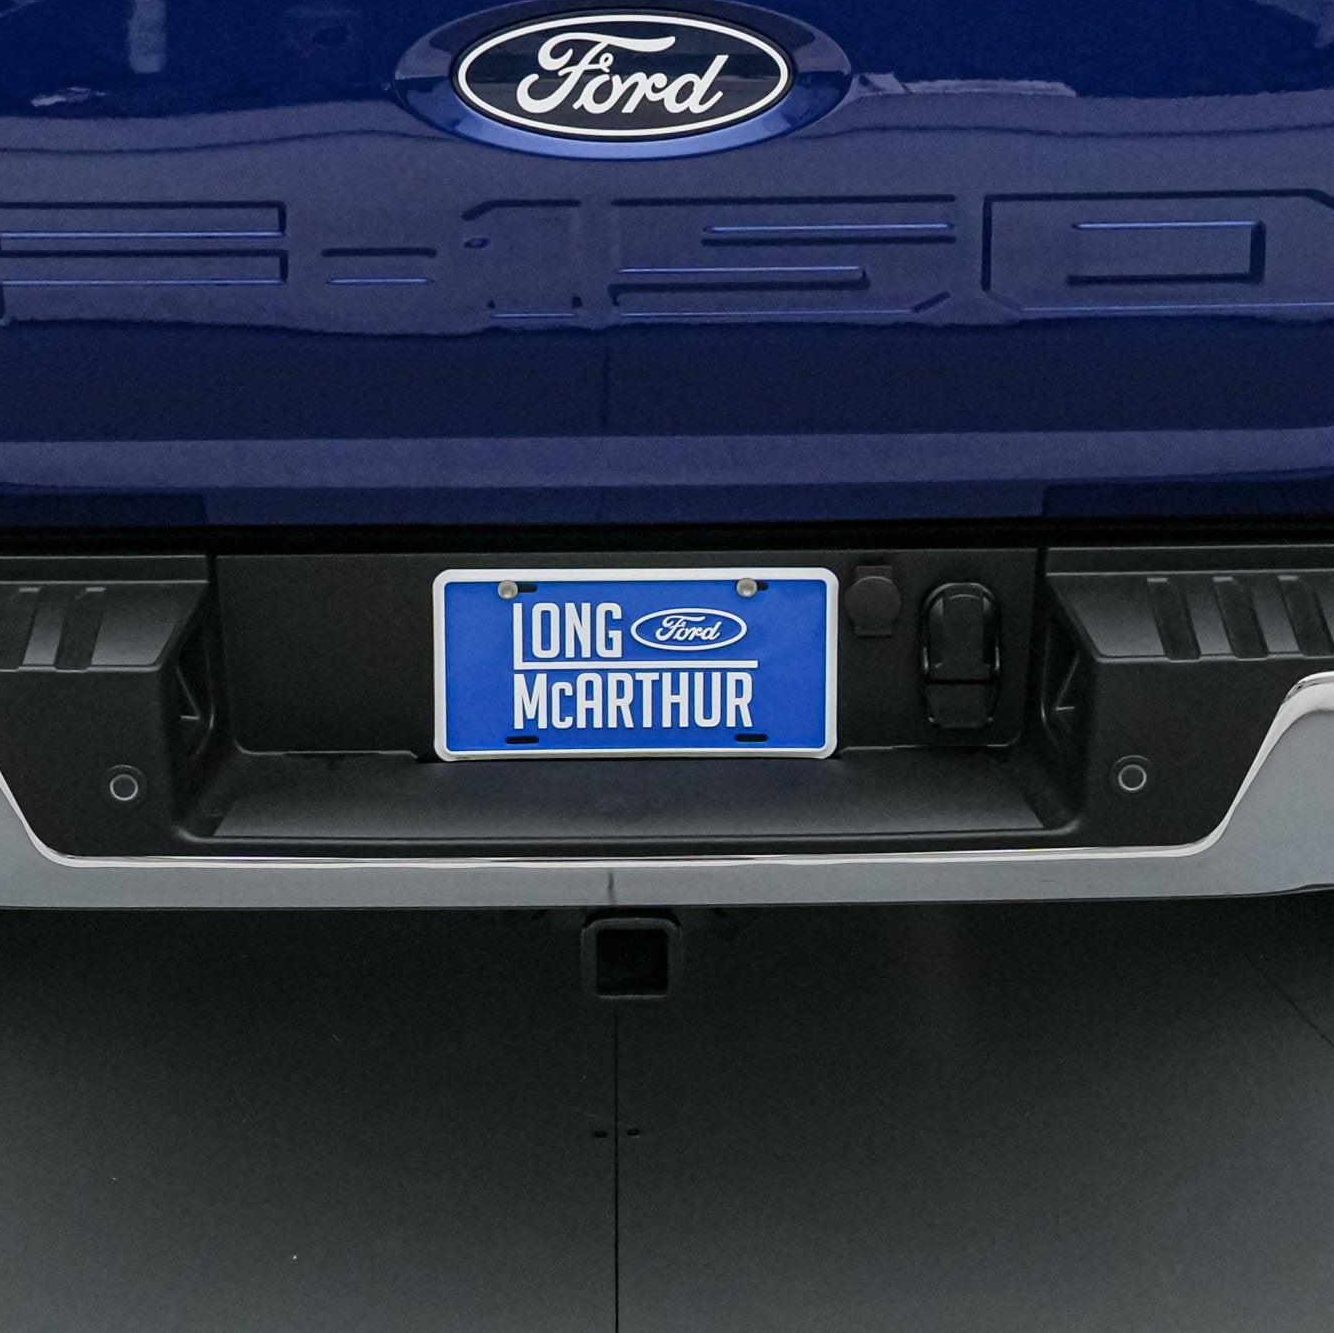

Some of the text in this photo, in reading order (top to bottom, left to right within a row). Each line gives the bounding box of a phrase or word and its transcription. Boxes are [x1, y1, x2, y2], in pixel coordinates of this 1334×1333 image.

[515, 31, 729, 115] Ford
[513, 602, 723, 669] LONG Ford
[513, 671, 754, 730] McARTHUR
